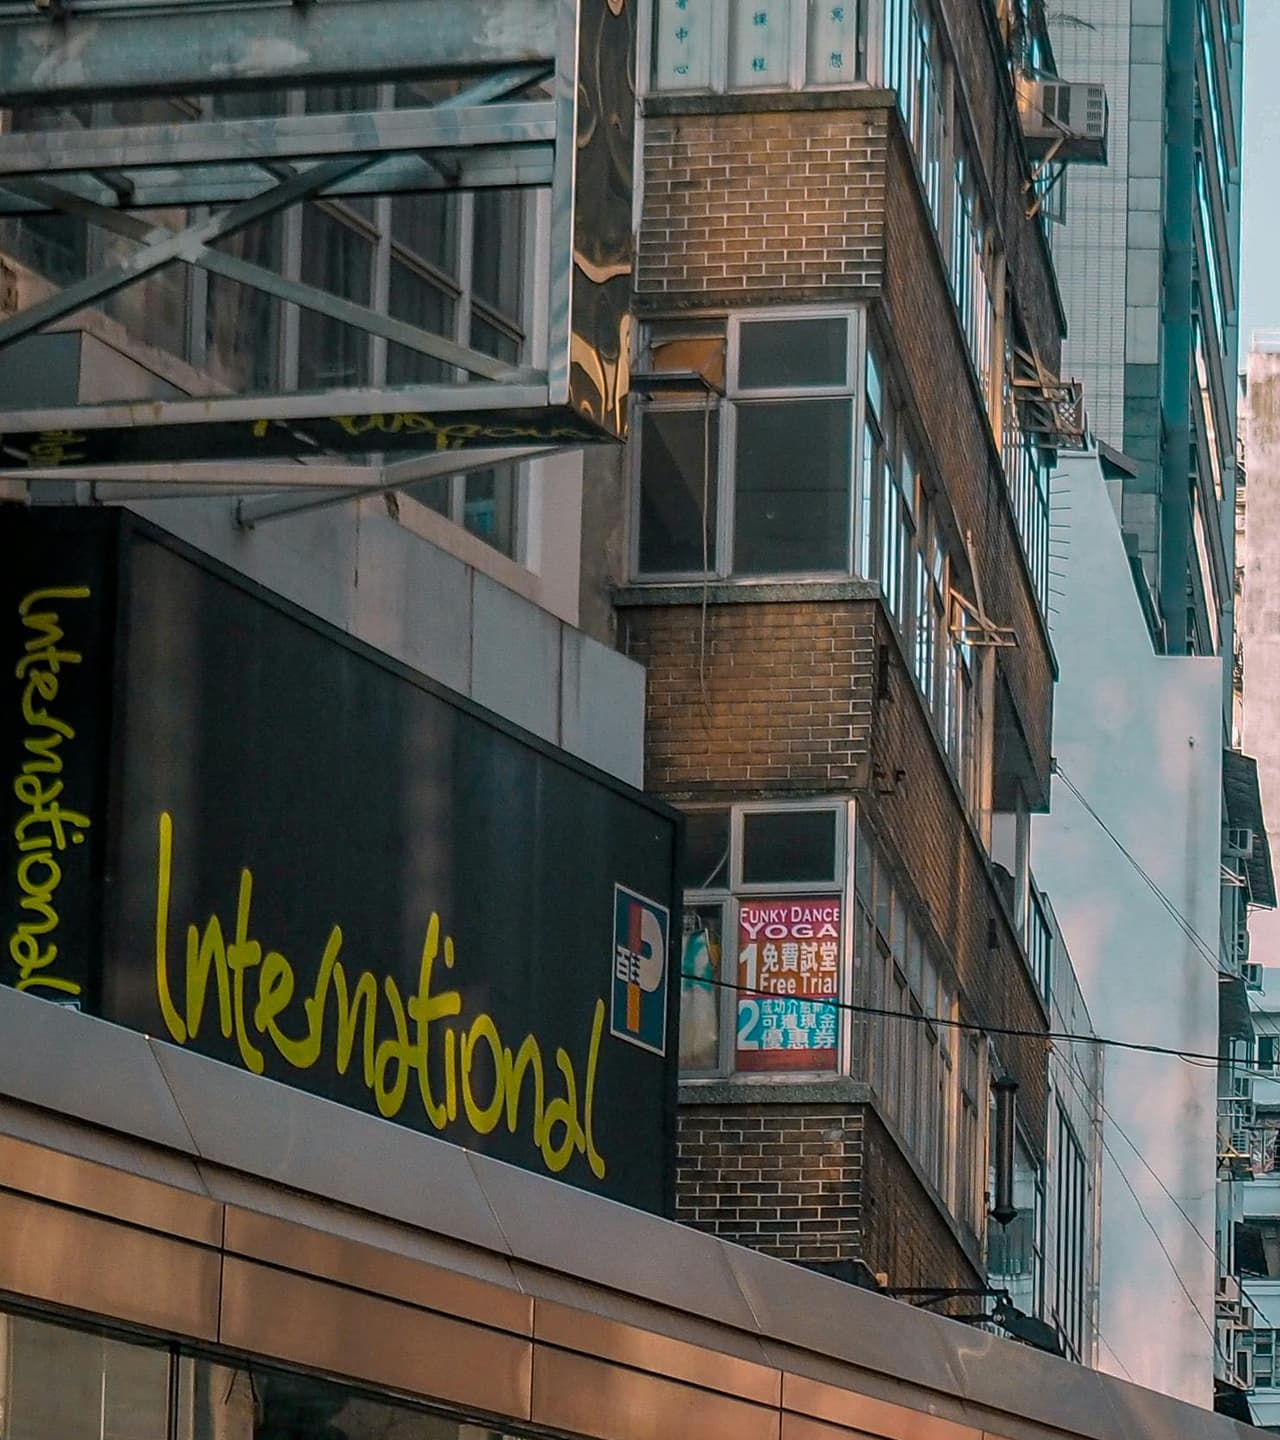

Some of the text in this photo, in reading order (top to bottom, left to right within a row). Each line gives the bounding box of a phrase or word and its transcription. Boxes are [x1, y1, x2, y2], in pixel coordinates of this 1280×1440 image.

[10, 586, 91, 996] International
[740, 906, 839, 924] FUNKY DANCE
[740, 924, 838, 940] YOGA
[739, 944, 757, 995] 1
[761, 942, 837, 972] 免費試堂
[156, 810, 606, 1179] International
[760, 973, 837, 994] Free Trial
[738, 1000, 760, 1050] 2
